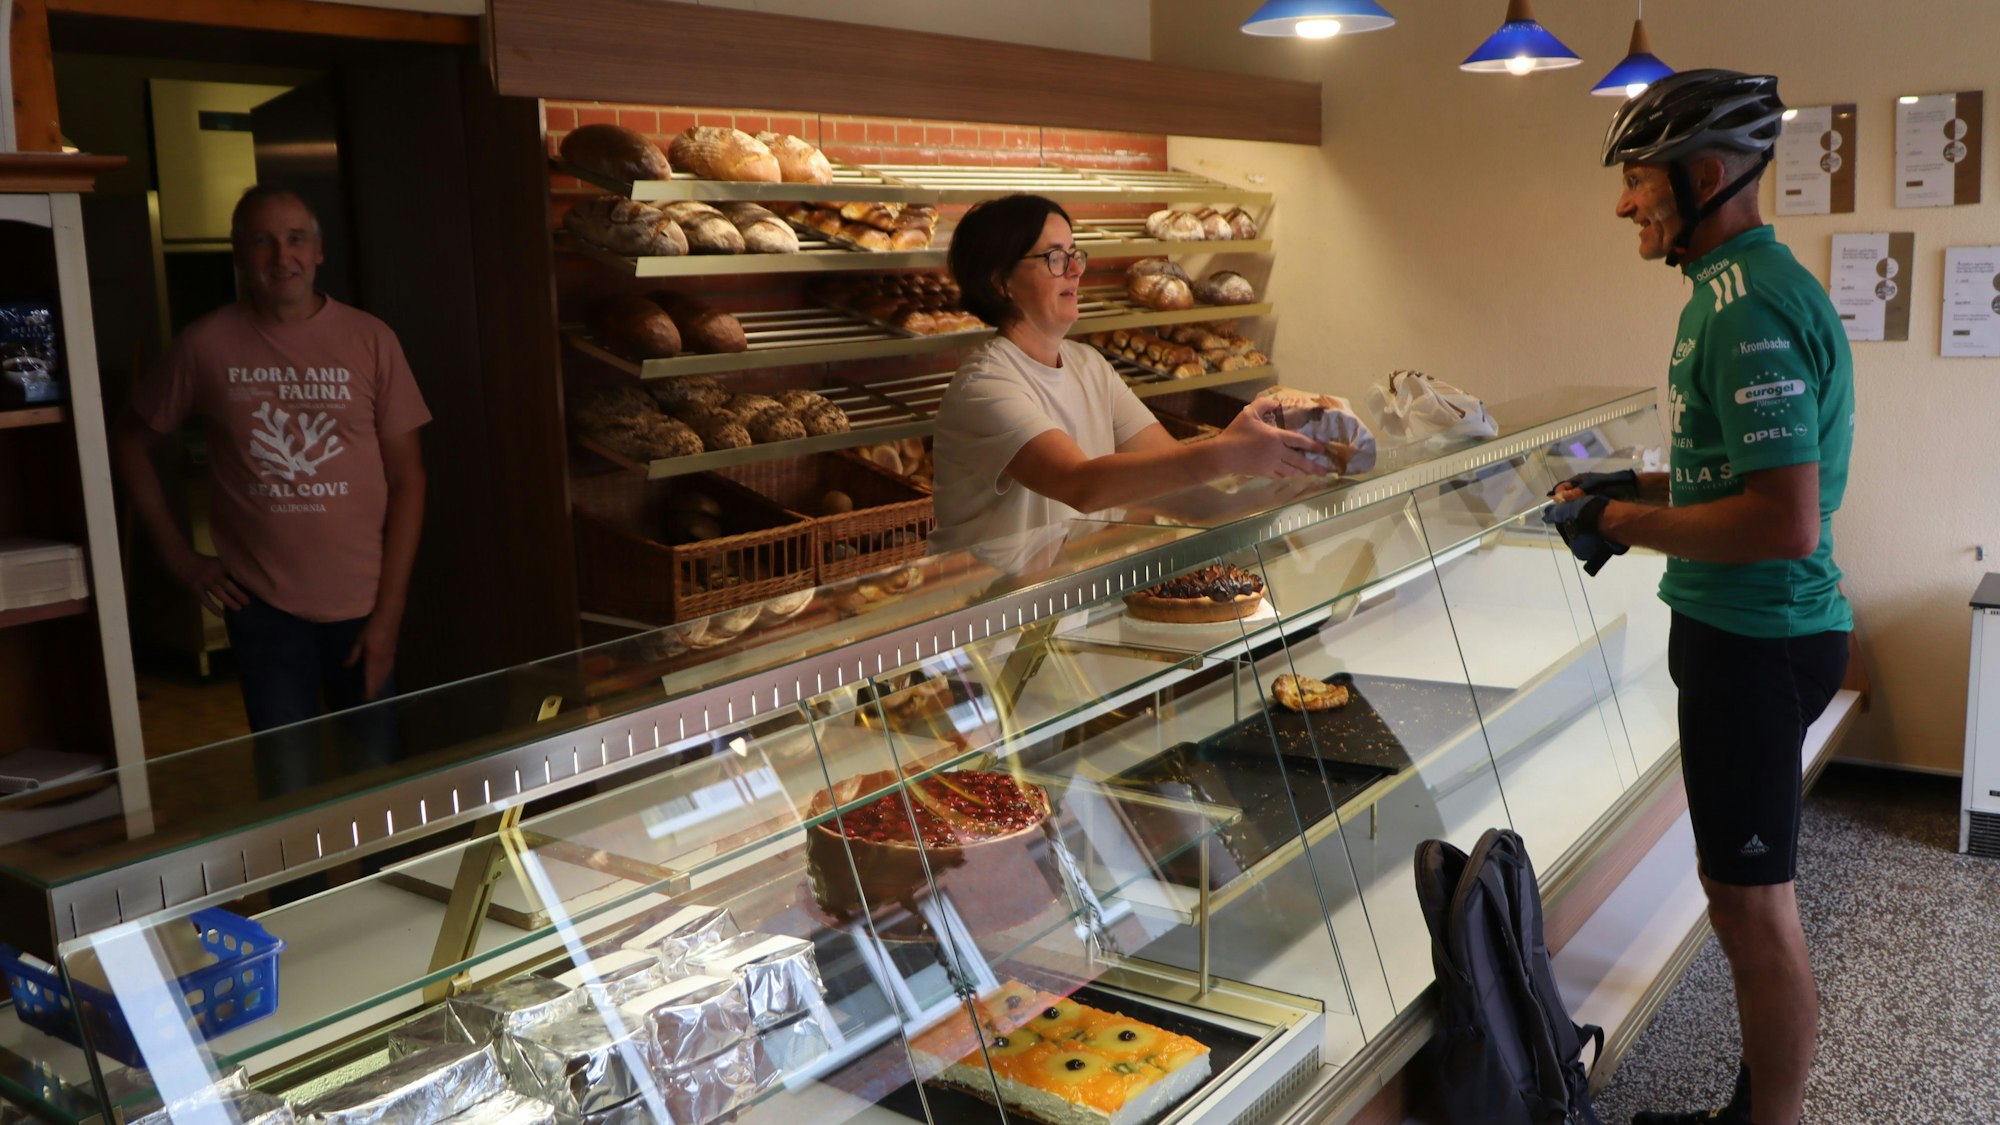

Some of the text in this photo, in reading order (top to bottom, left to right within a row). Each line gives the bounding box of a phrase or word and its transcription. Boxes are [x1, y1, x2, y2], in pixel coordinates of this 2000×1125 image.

[1696, 258, 1730, 282] adidas
[1740, 337, 1791, 354] Krombacher
[228, 367, 350, 383] FLORA AND
[278, 384, 351, 400] FAUNA
[1745, 383, 1794, 400] eurogel
[1743, 427, 1793, 444] OPEL
[248, 481, 349, 497] SEAL COVE
[271, 503, 326, 513] CALIFORNIA
